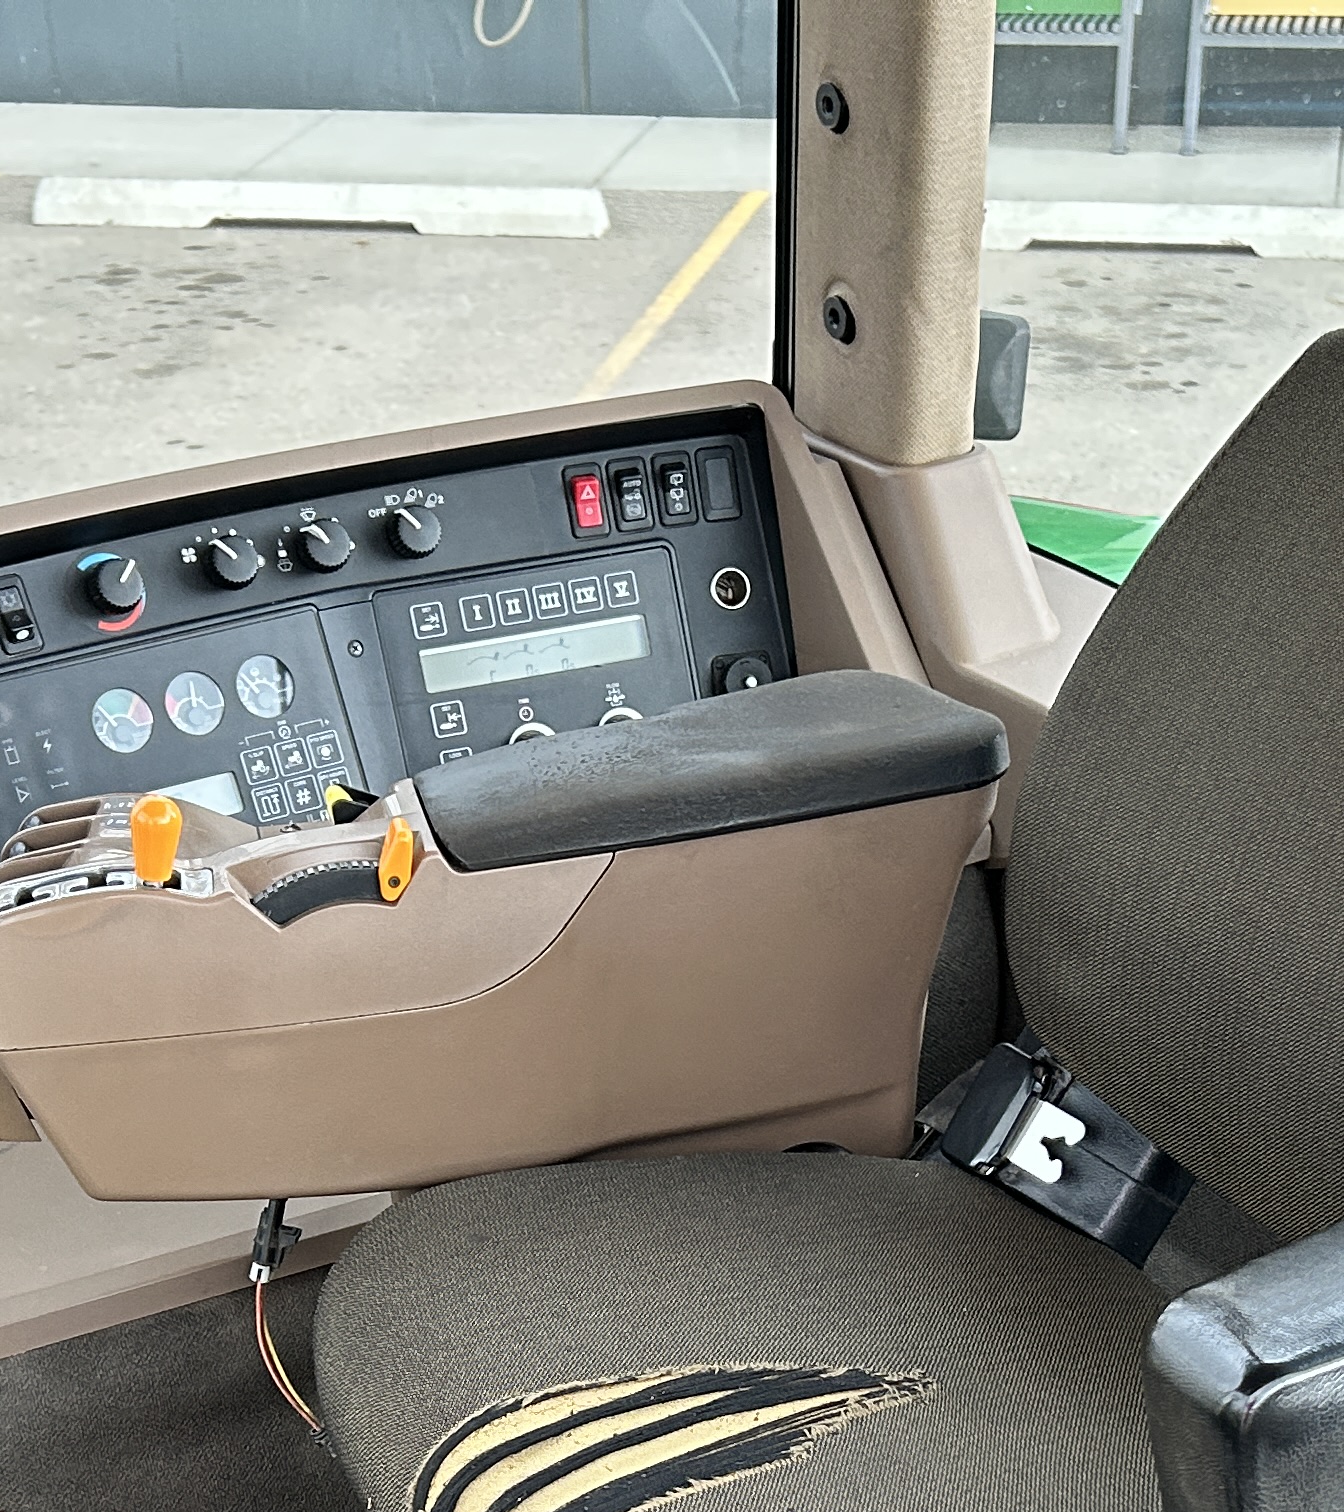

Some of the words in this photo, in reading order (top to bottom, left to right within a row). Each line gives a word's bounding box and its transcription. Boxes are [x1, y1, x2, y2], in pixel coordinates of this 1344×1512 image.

[368, 507, 387, 518] OFF
[574, 586, 597, 604] IV
[613, 581, 630, 598] V
[506, 599, 522, 616] II
[539, 592, 561, 610] III
[472, 604, 483, 620] I
